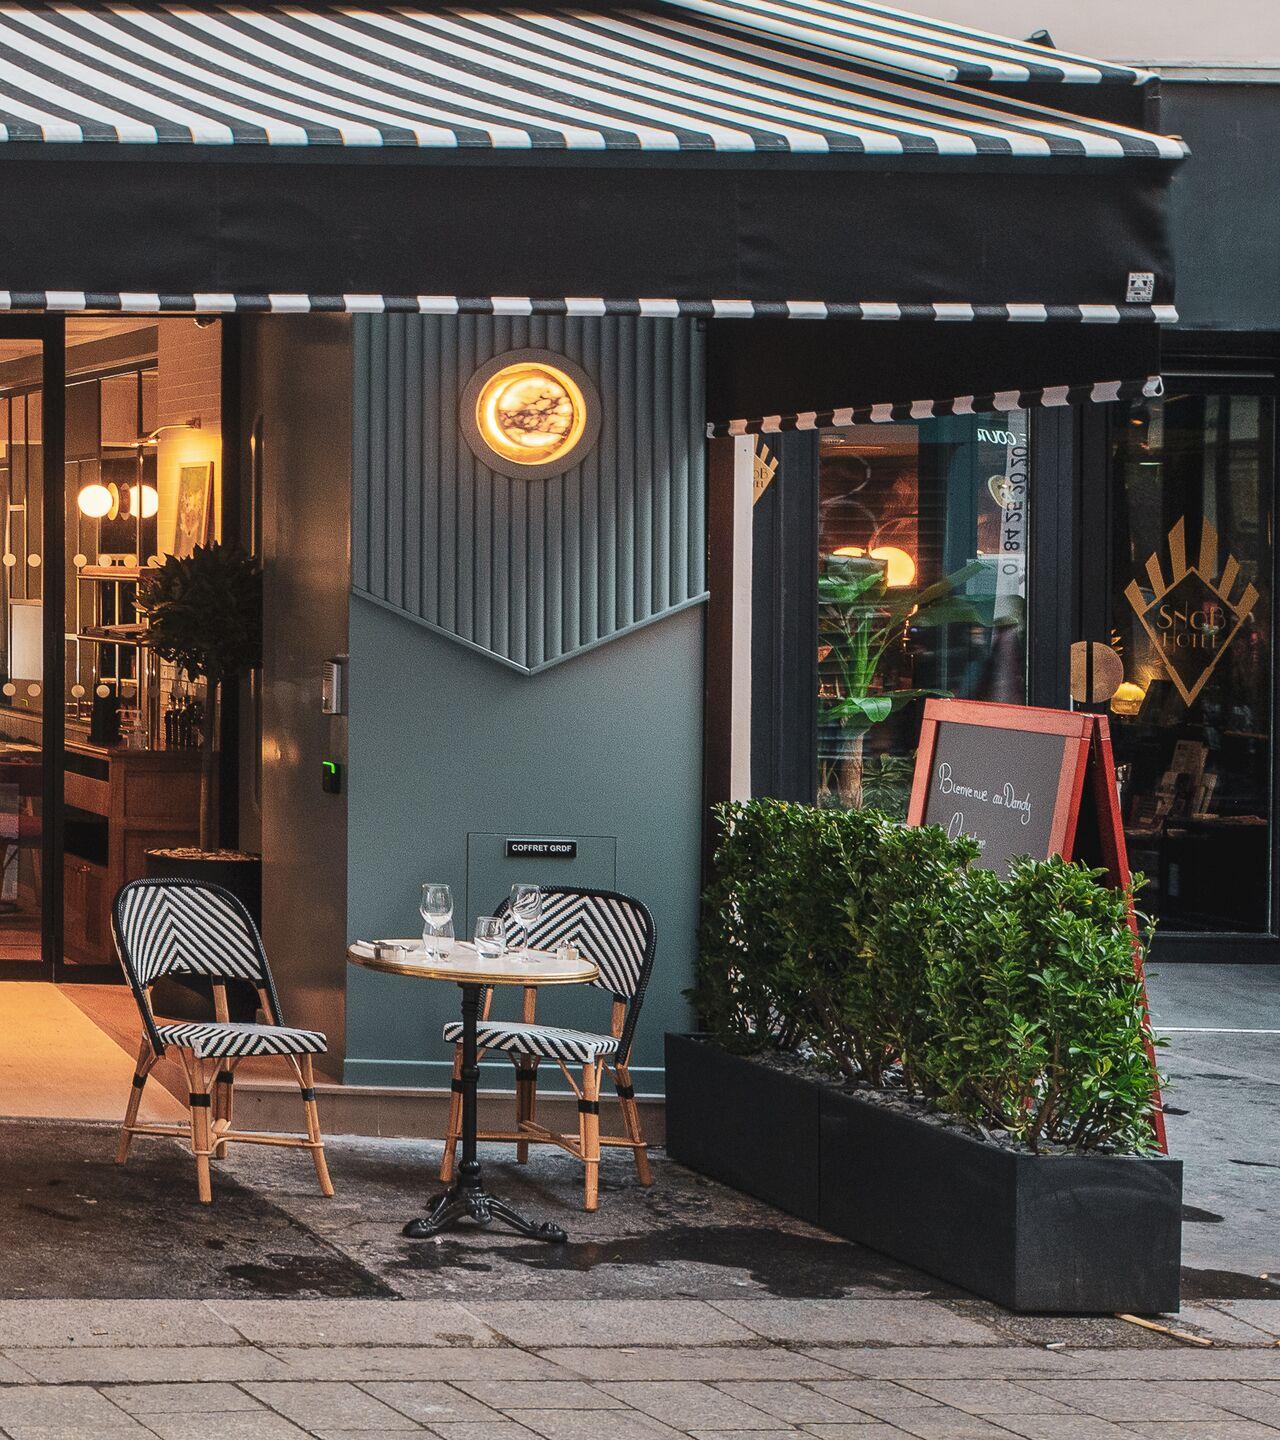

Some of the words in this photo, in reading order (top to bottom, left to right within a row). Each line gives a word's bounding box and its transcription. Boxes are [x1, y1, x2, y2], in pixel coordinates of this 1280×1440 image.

[1156, 600, 1227, 632] SNOB
[939, 762, 988, 802] Bienvenue
[992, 795, 1003, 806] au
[1003, 782, 1032, 825] Dandy
[511, 844, 548, 852] COFFRET
